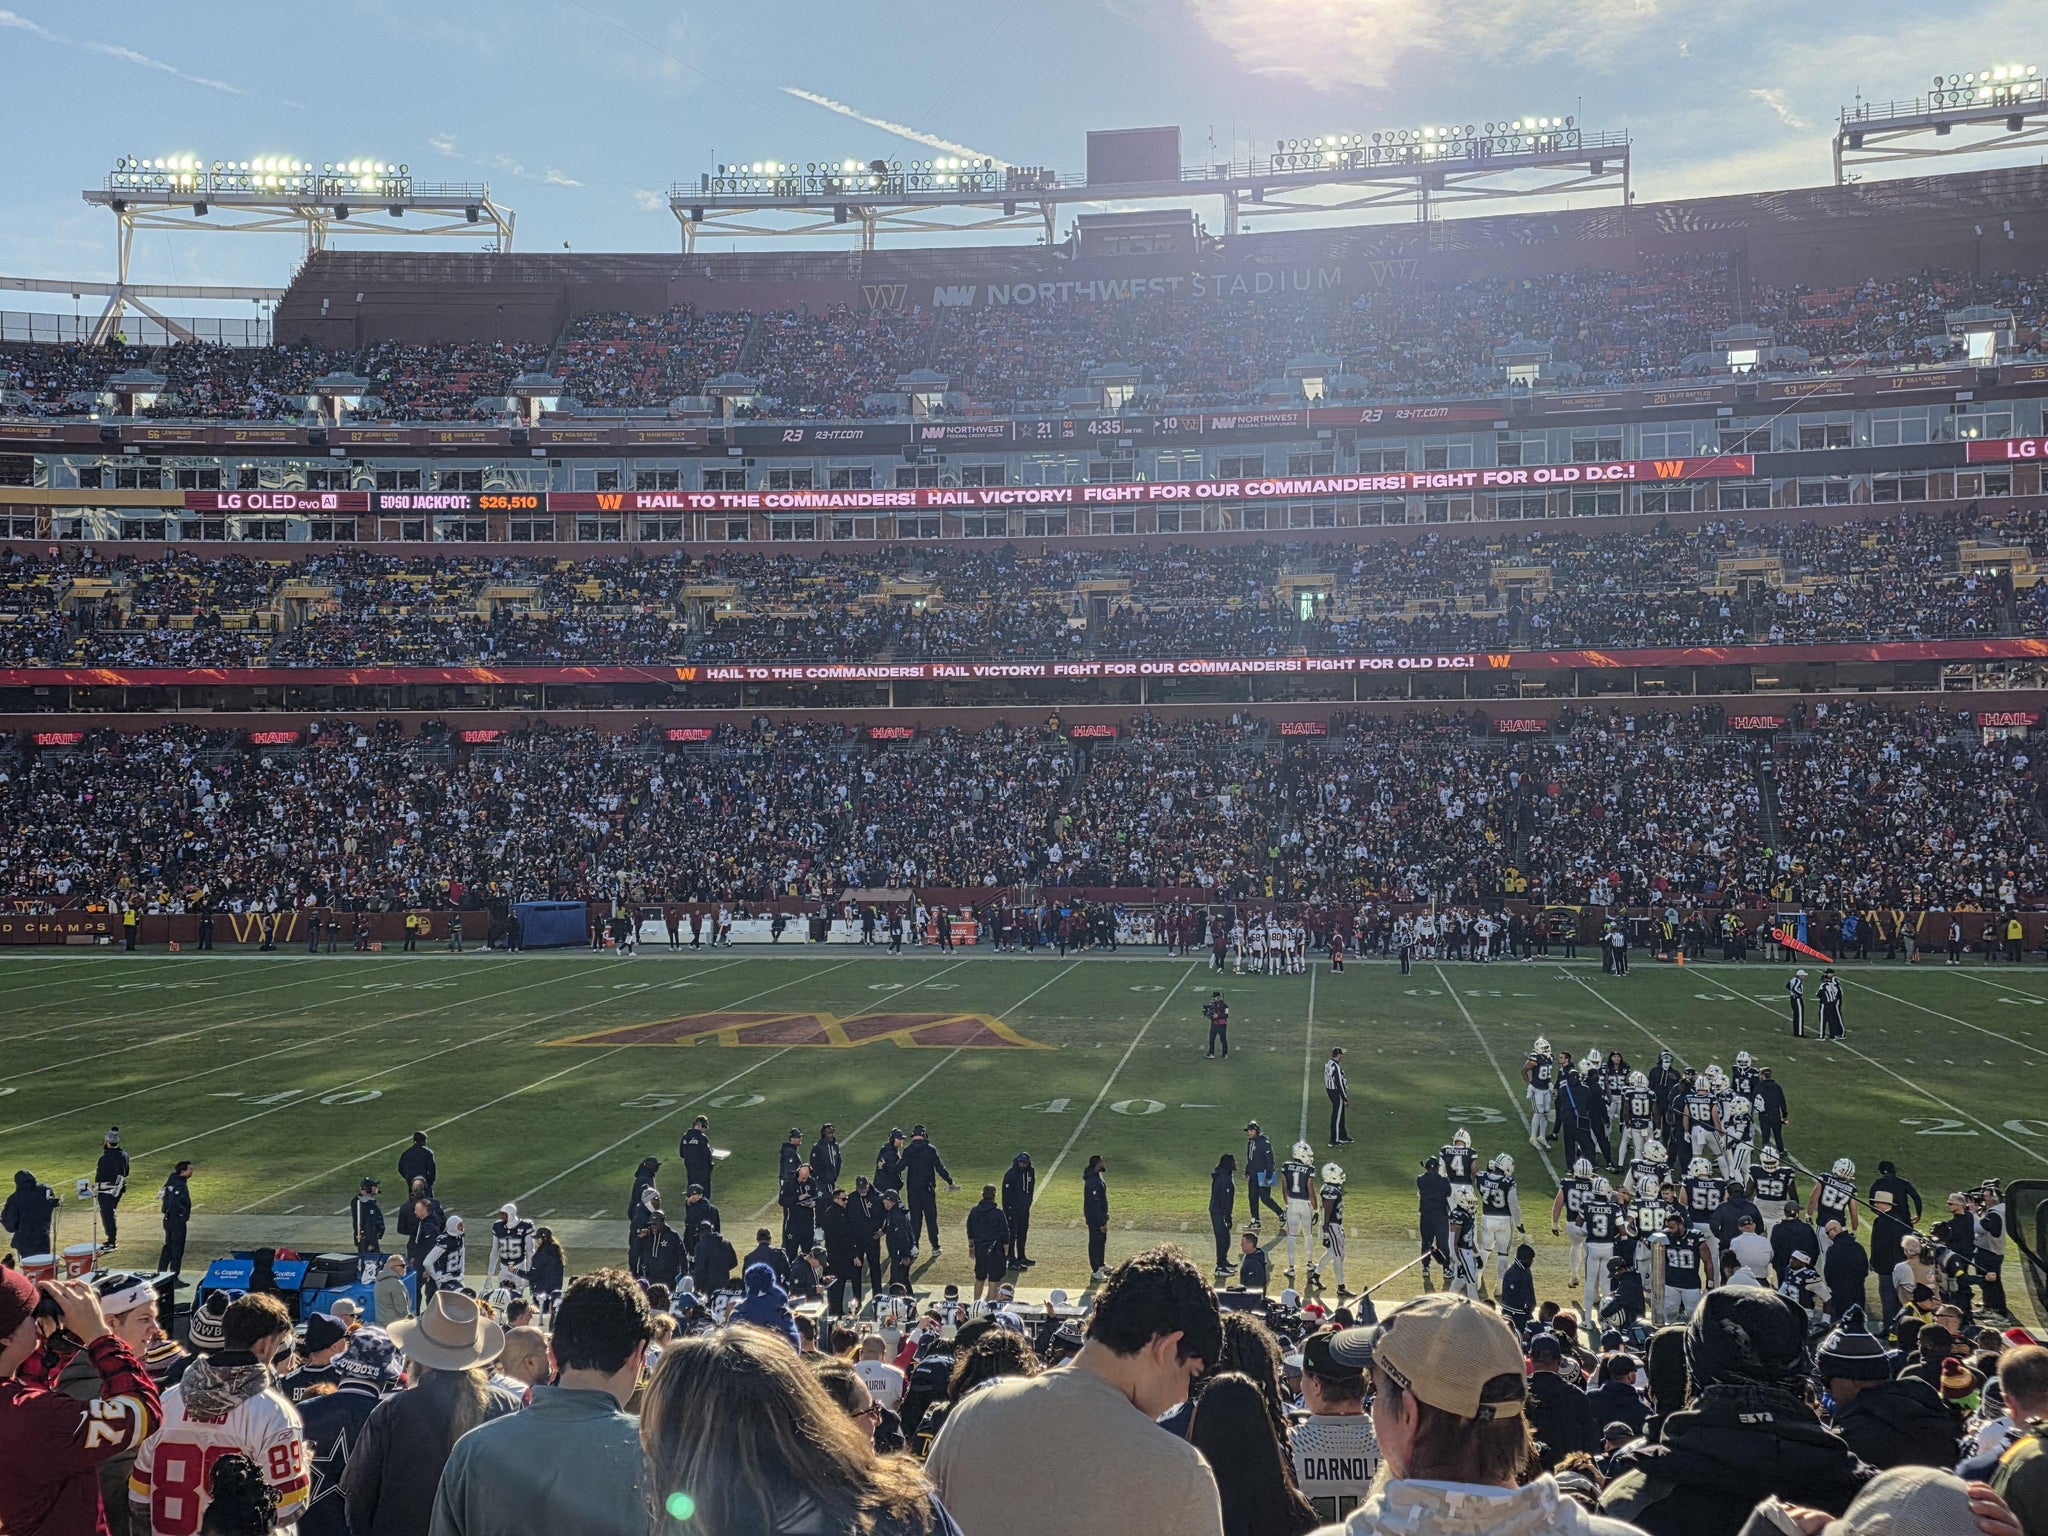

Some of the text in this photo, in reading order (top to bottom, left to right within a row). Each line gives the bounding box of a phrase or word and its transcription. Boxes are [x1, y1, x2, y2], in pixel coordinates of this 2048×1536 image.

[987, 276, 1185, 306] NORTHWEST
[1192, 266, 1342, 297] STADIUM
[1992, 321, 2007, 329] 405
[2031, 368, 2047, 379] 35
[1892, 378, 1904, 388] 17
[1783, 385, 1797, 395] 43
[1654, 393, 1667, 404] 20
[1161, 417, 1178, 430] 10
[1237, 413, 1299, 424] NORTHWEST
[946, 425, 1004, 434] NORTHWEST
[1037, 422, 1052, 434] 21
[1087, 420, 1122, 434] 4:35
[147, 430, 160, 439] 56
[235, 431, 247, 441] 27
[351, 432, 363, 441] 87
[440, 432, 453, 442] 84
[552, 432, 563, 441] 57
[639, 432, 645, 441] 3
[2007, 440, 2036, 458] LG
[636, 495, 684, 508] HAIL
[687, 495, 716, 508] TO
[719, 495, 760, 508] THE
[765, 493, 917, 508] COMMANDERS!
[927, 491, 975, 505] HAIL
[978, 489, 1073, 504] VICTORY!
[1083, 486, 1145, 501] FIGHT
[1149, 485, 1191, 499] FOR
[1195, 483, 1240, 497] OUR
[1244, 476, 1407, 496] COMMANDERS!
[1412, 472, 1478, 489] FIGHT
[1483, 469, 1528, 485] FOR
[1533, 467, 1580, 482] OLD
[1586, 464, 1636, 480] D.C.!
[217, 494, 241, 509] LG
[247, 494, 297, 510] OLED
[298, 500, 319, 511] evo
[412, 495, 471, 509] JACKPOT:
[478, 495, 538, 510] $26,510
[706, 668, 744, 679] HAIL
[747, 668, 770, 678] TO
[771, 668, 803, 678] THE
[805, 667, 924, 679] COMMANDERS!
[932, 666, 970, 677] HAIL
[973, 665, 1046, 677] VICTORY!
[1053, 664, 1101, 675] FIGHT
[1104, 664, 1137, 674] FOR
[1139, 663, 1175, 673] OUR
[1177, 660, 1302, 673] COMMANDERS!
[1306, 659, 1356, 670] FIGHT
[1359, 658, 1394, 669] FOR
[1397, 657, 1433, 669] OLD
[1437, 656, 1475, 668] D.C.!
[1500, 719, 1541, 732] HAIL
[1735, 716, 1778, 729] HAIL
[1985, 712, 2032, 726] HAIL
[670, 729, 707, 741] HAIL
[872, 727, 909, 738] HAIL
[1074, 725, 1111, 737] HAIL
[1281, 722, 1321, 735] HAIL
[38, 732, 78, 745] HAIL
[255, 731, 293, 744] HAIL
[24, 922, 107, 933] CHAMPS
[1271, 932, 1282, 941] 80
[1608, 1075, 1626, 1090] 35
[1736, 1078, 1751, 1093] 14
[1631, 1099, 1651, 1117] 81
[1689, 1103, 1711, 1121] 86
[1450, 1155, 1465, 1177] 4
[1292, 1172, 1301, 1193] 1
[1484, 1180, 1500, 1190] SMITH
[1575, 1183, 1590, 1191] BASS
[1757, 1179, 1784, 1196] 52
[1480, 1186, 1506, 1209] 73
[1691, 1187, 1721, 1211] 56
[1820, 1184, 1851, 1210] 87
[1588, 1205, 1612, 1215] PICKENS
[1644, 1200, 1660, 1208] LAMB
[1592, 1214, 1608, 1237] 3
[1638, 1207, 1667, 1232] 88
[68, 1262, 81, 1276] G
[221, 1268, 244, 1277] Copilot
[192, 1316, 222, 1337] COWB
[337, 1358, 380, 1377] COWBOYS
[865, 1379, 887, 1391] AURIN
[267, 1440, 301, 1480] 89
[1304, 1457, 1379, 1481] DARNOL
